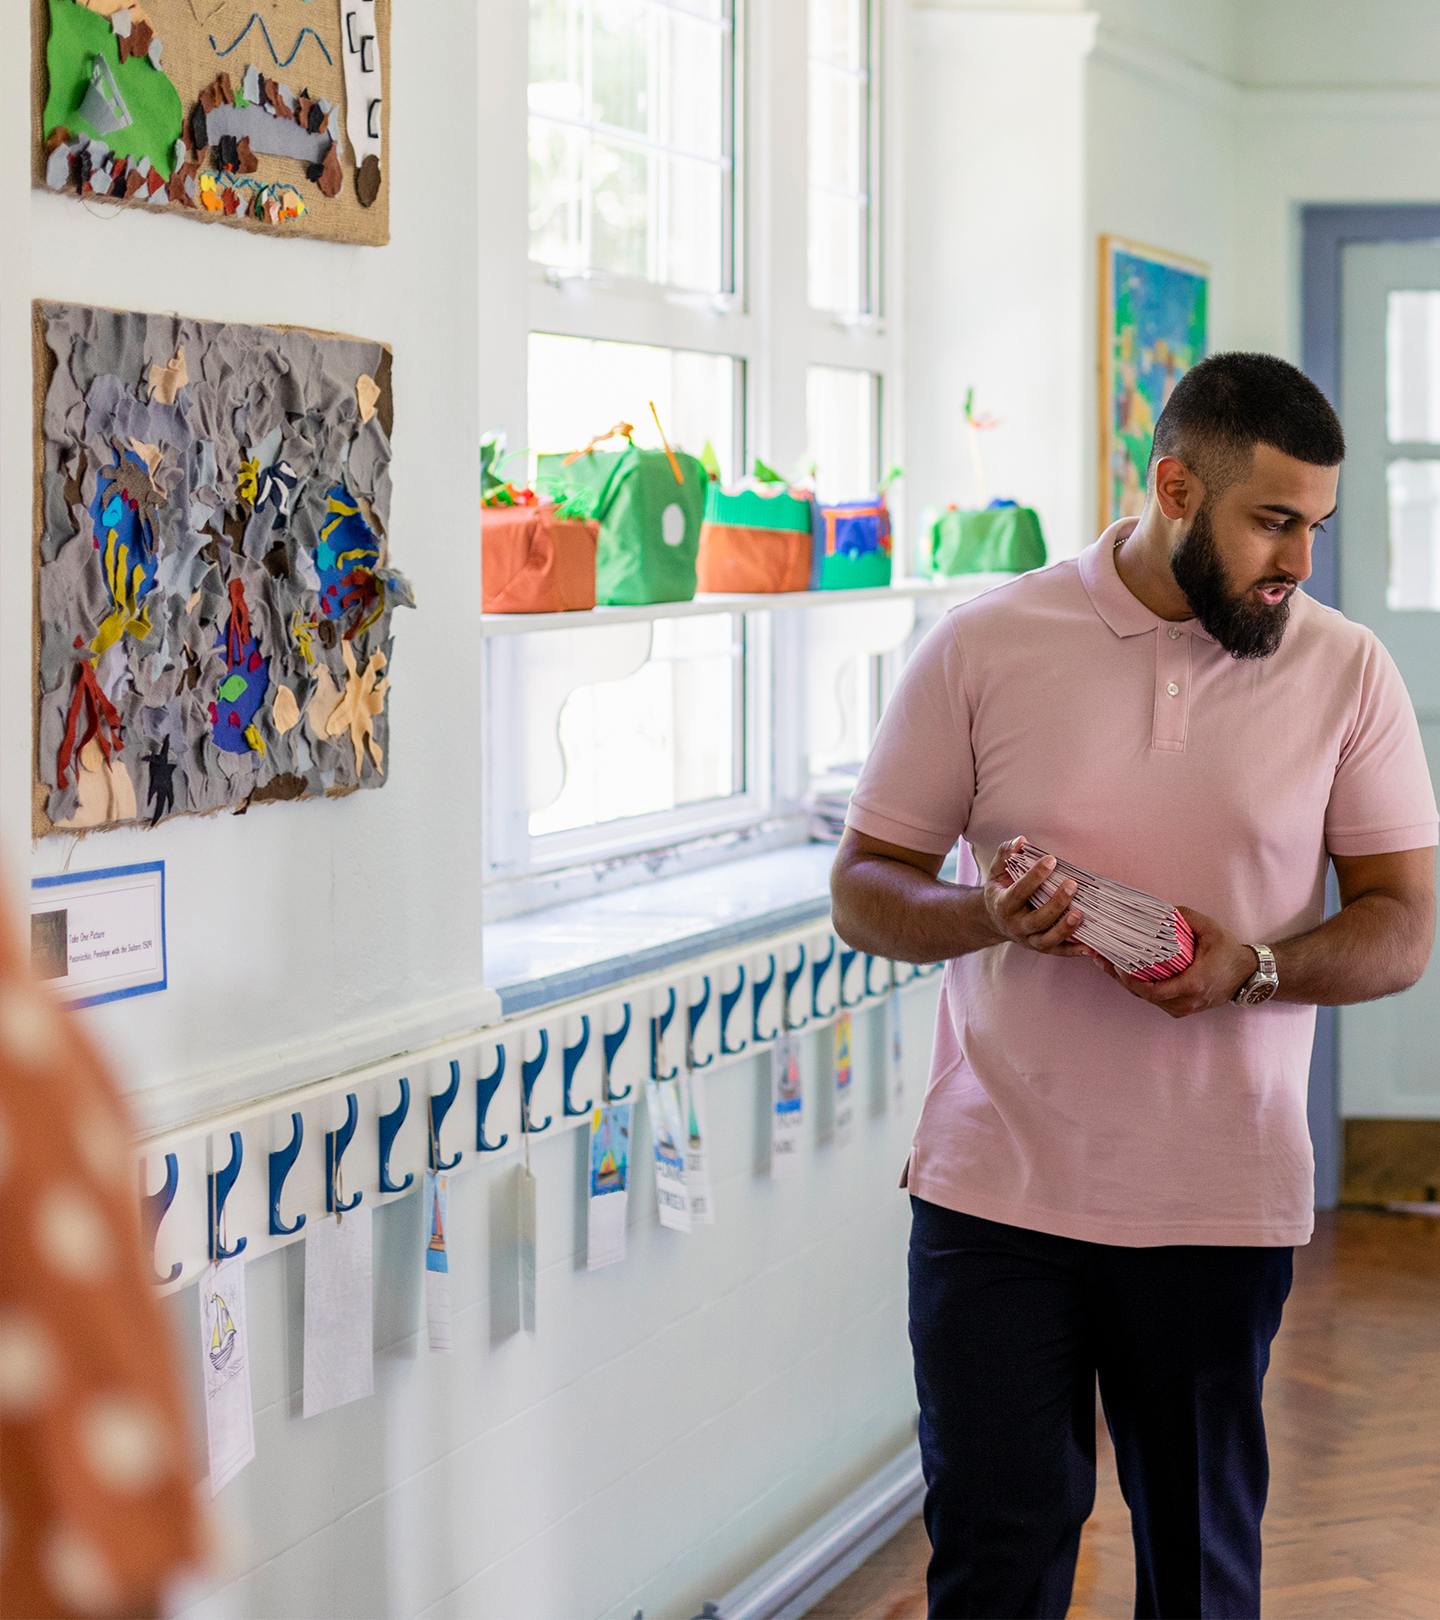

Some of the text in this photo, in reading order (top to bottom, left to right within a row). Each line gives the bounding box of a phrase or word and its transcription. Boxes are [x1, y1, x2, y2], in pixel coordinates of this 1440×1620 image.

[69, 931, 105, 943] Take One Picture
[112, 946, 120, 955] with
